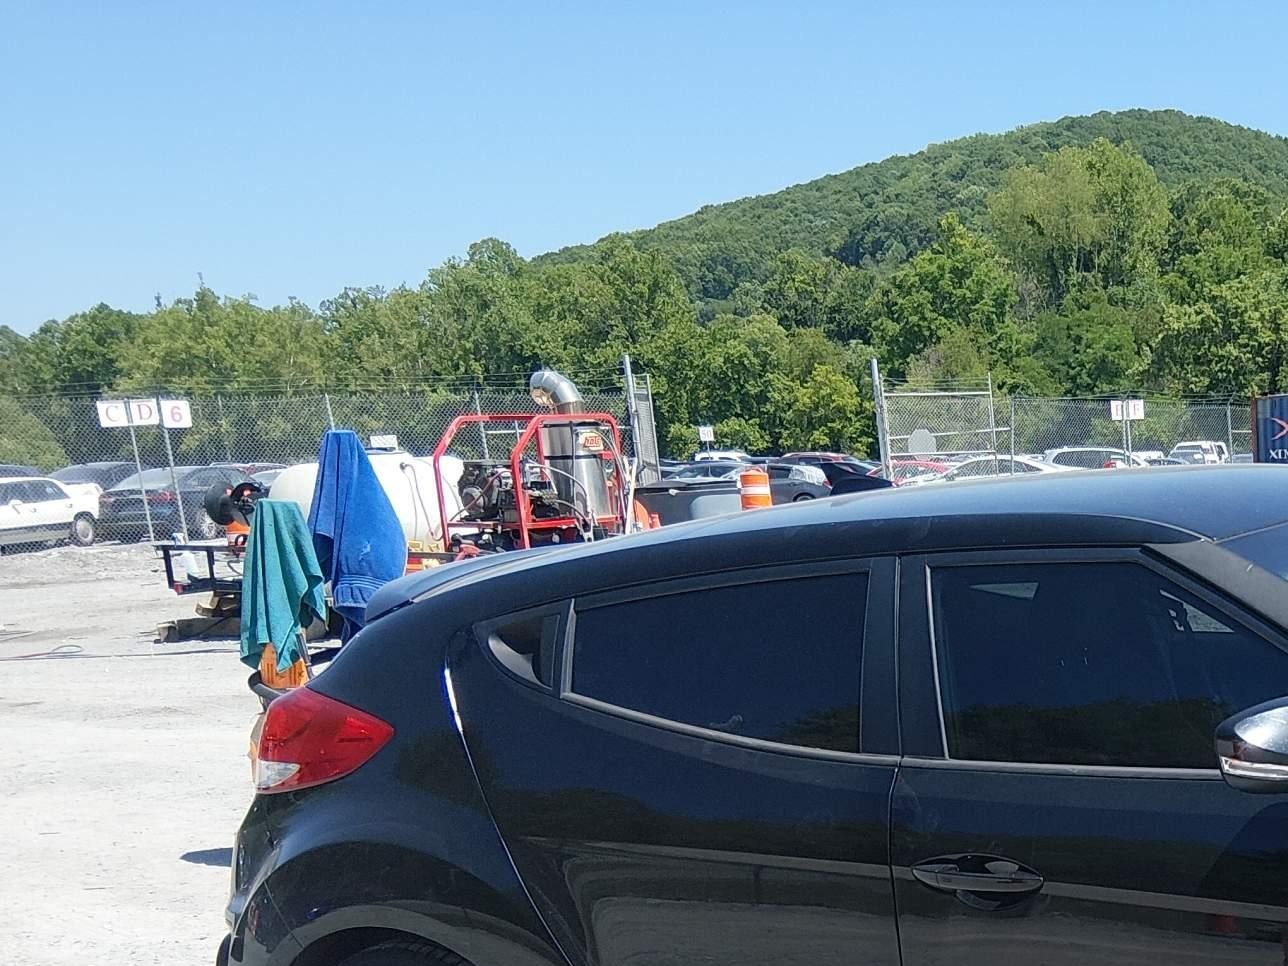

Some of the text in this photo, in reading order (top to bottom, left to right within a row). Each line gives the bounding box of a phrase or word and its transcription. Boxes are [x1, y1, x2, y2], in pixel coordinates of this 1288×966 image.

[105, 405, 120, 422] C
[137, 403, 153, 421] D
[170, 406, 183, 422] 6
